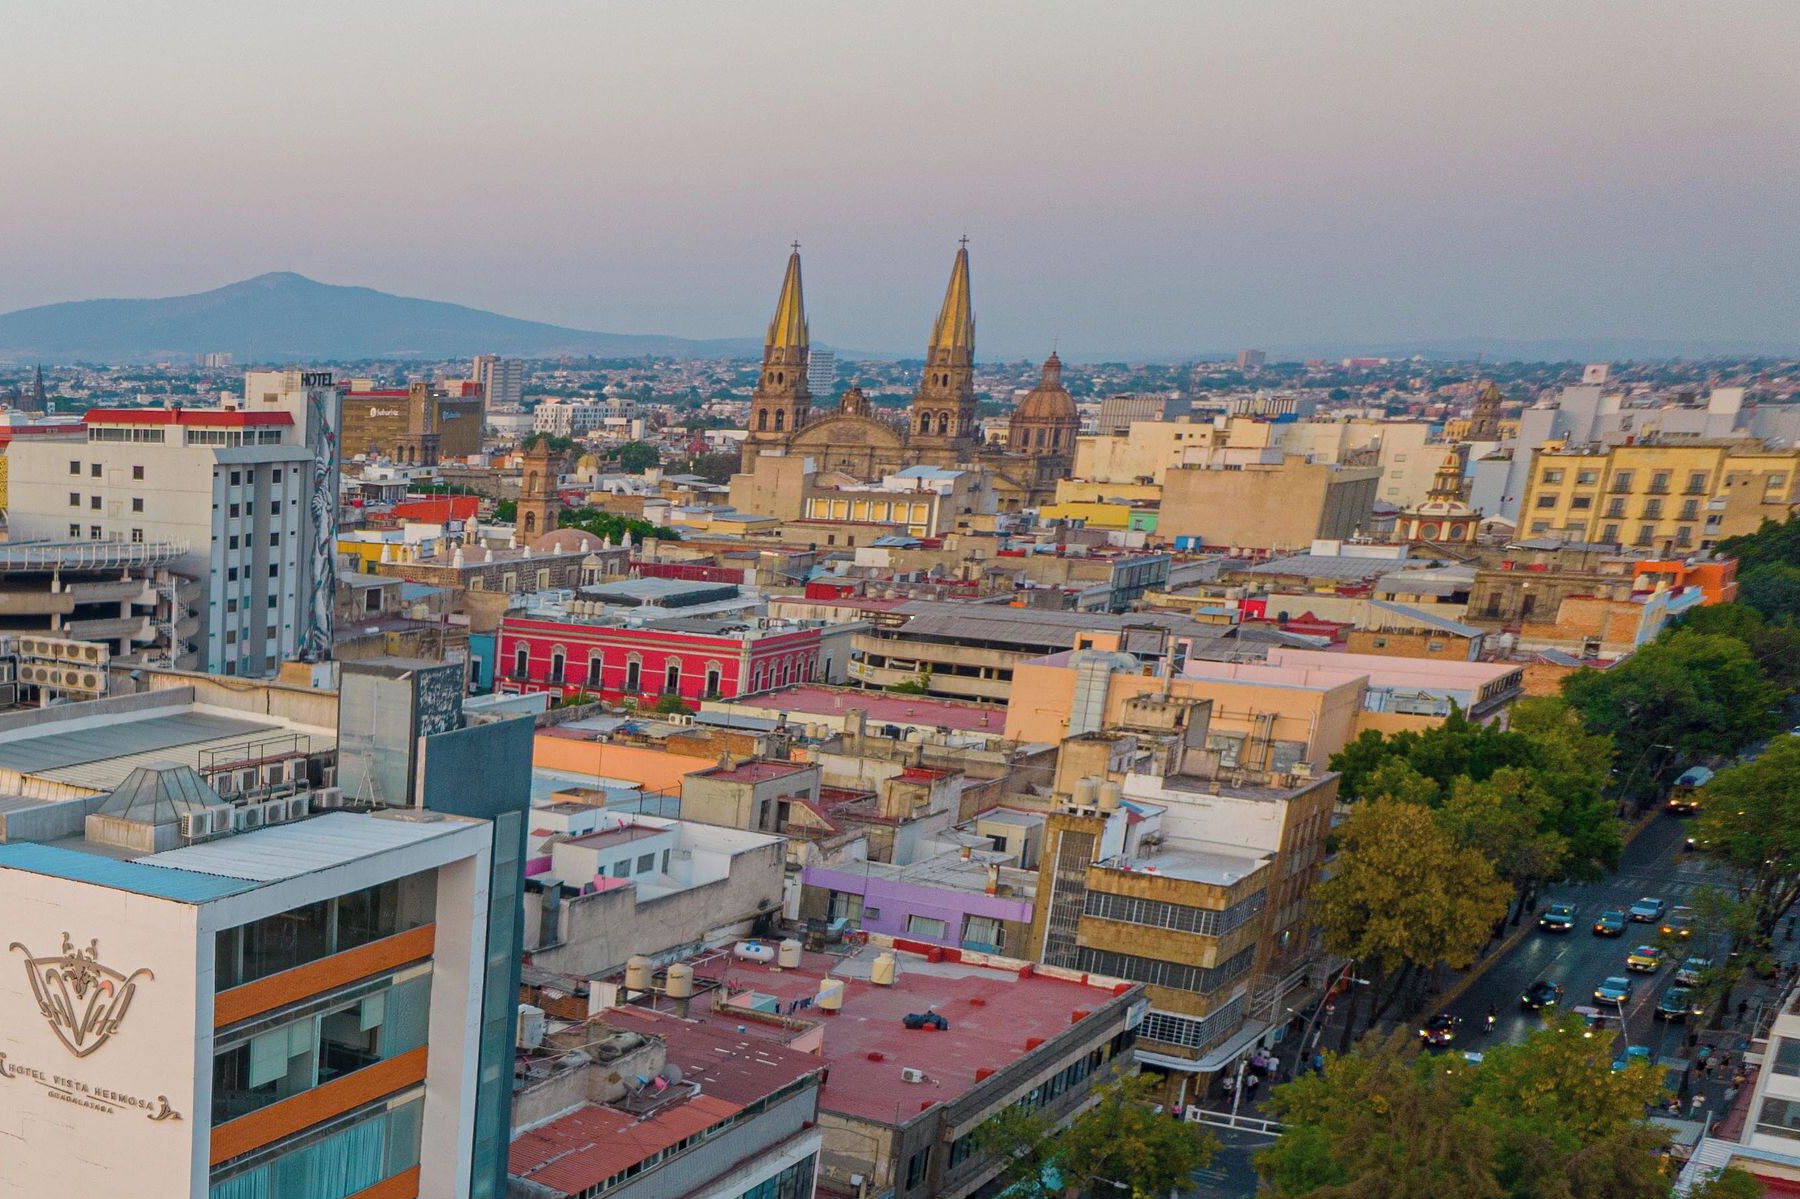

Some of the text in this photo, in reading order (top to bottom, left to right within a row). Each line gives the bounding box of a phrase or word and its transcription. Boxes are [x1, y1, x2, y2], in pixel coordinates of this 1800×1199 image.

[301, 373, 335, 387] HOTEL
[8, 1064, 154, 1111] HOTEL VISTA HERMOSA
[48, 1090, 114, 1114] GUADALAJARA
